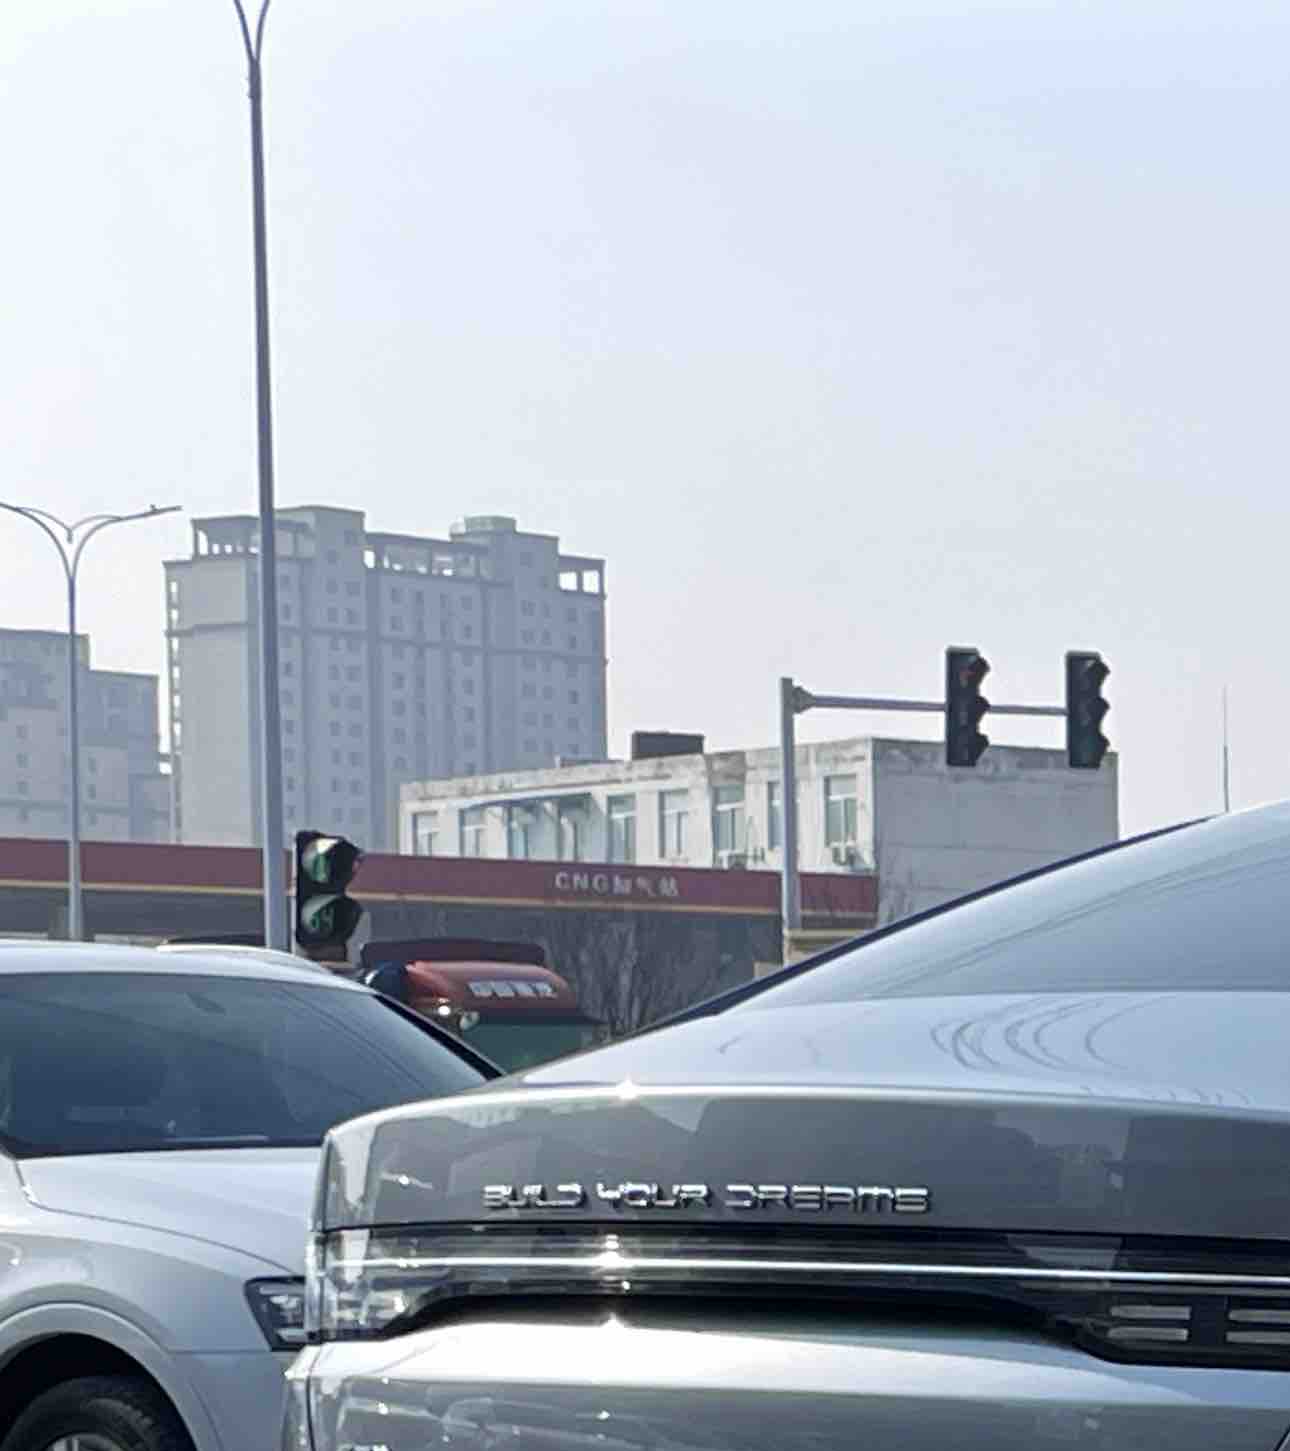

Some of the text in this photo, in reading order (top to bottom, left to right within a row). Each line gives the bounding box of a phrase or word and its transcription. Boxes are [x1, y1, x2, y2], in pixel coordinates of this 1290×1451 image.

[483, 1183, 930, 1213] BUILD YOUR DREAMS
